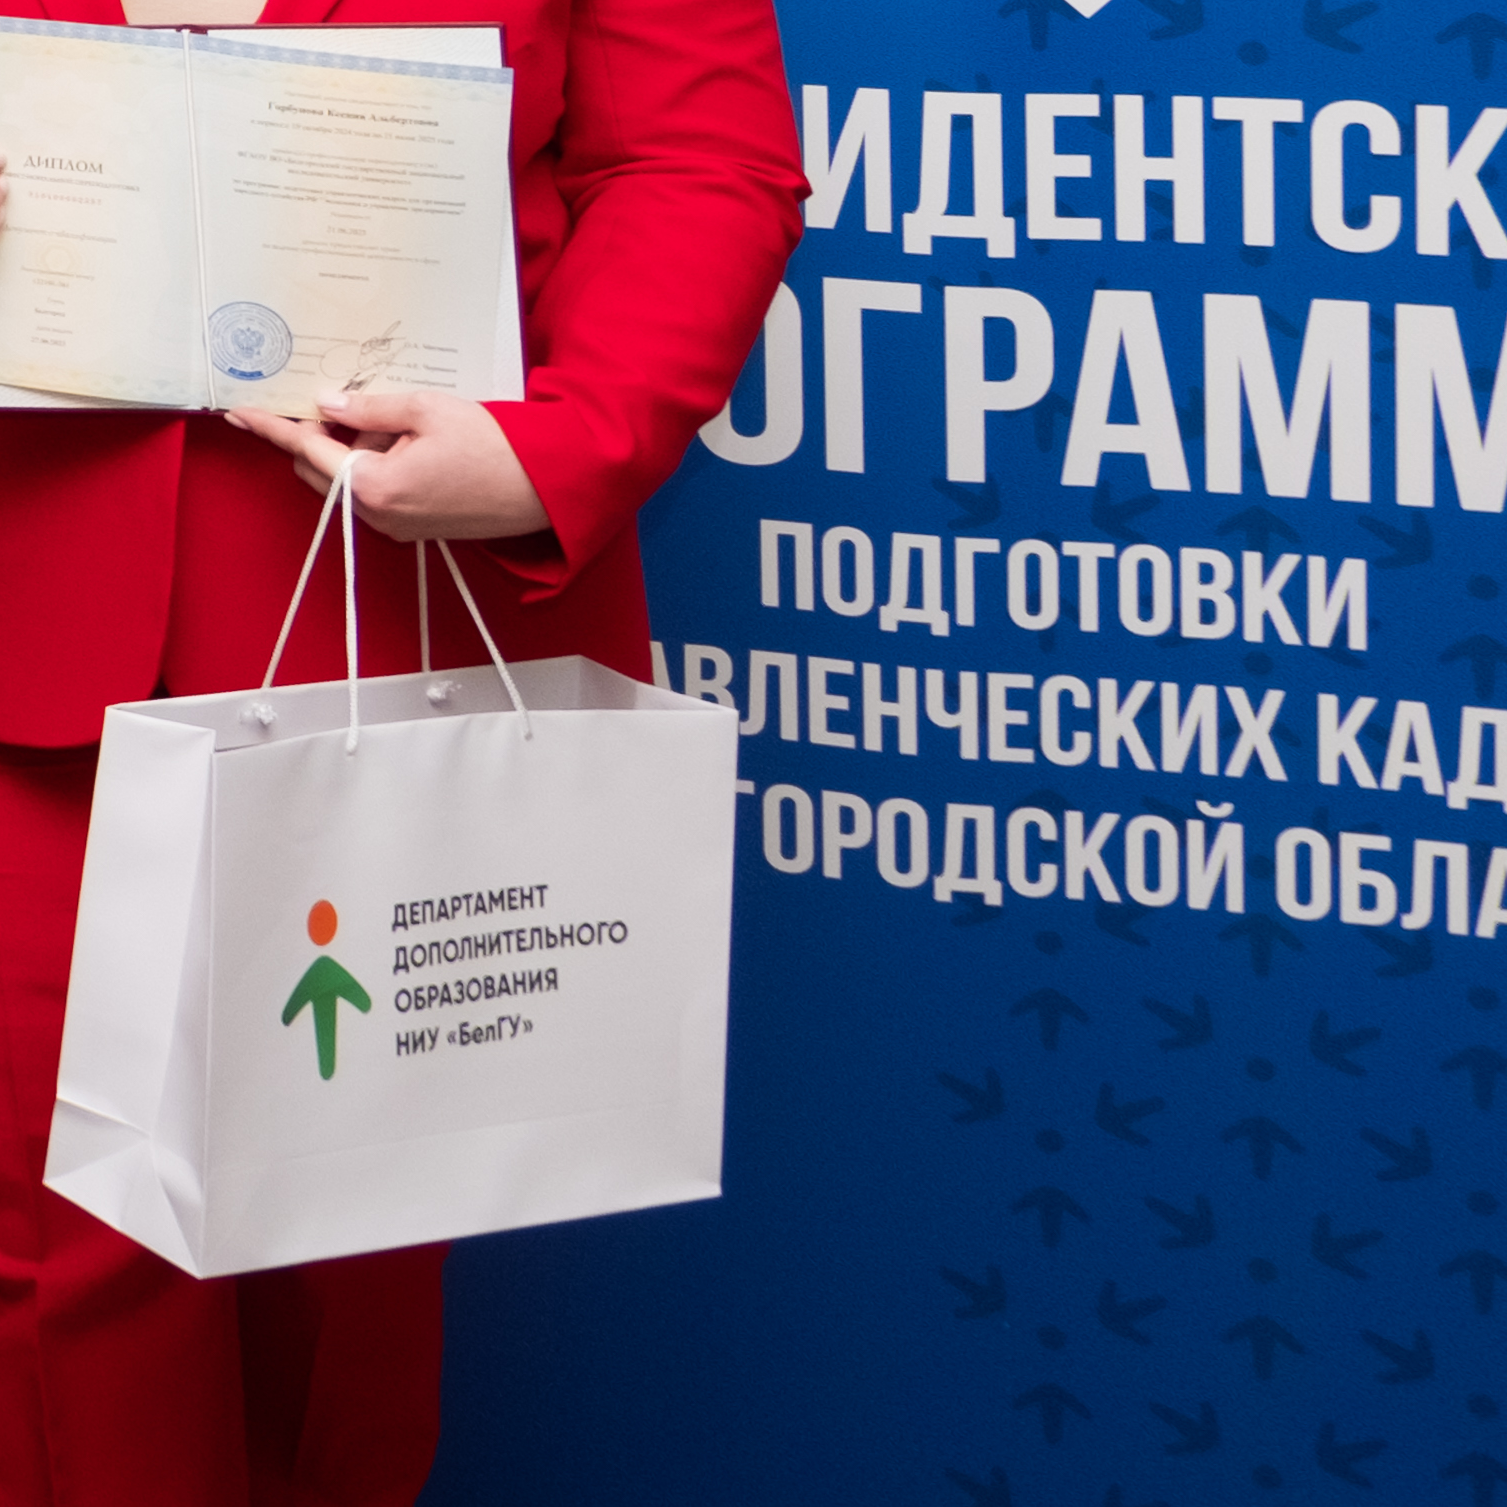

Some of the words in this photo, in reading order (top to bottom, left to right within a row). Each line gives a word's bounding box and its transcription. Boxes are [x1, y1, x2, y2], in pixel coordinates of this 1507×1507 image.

[23, 155, 104, 174] ДИПЛОМ
[759, 519, 1368, 651] ПОДГОТОВКИ
[391, 884, 549, 933] ДЕПАРТАМЕНТ
[393, 919, 628, 975] ДОПОЛНИТЕЛЬНОГО
[394, 967, 559, 1014] ОБРАЗОВАНИЯ
[396, 1026, 440, 1057] НИУ
[446, 1014, 534, 1048] «БелГУ»
